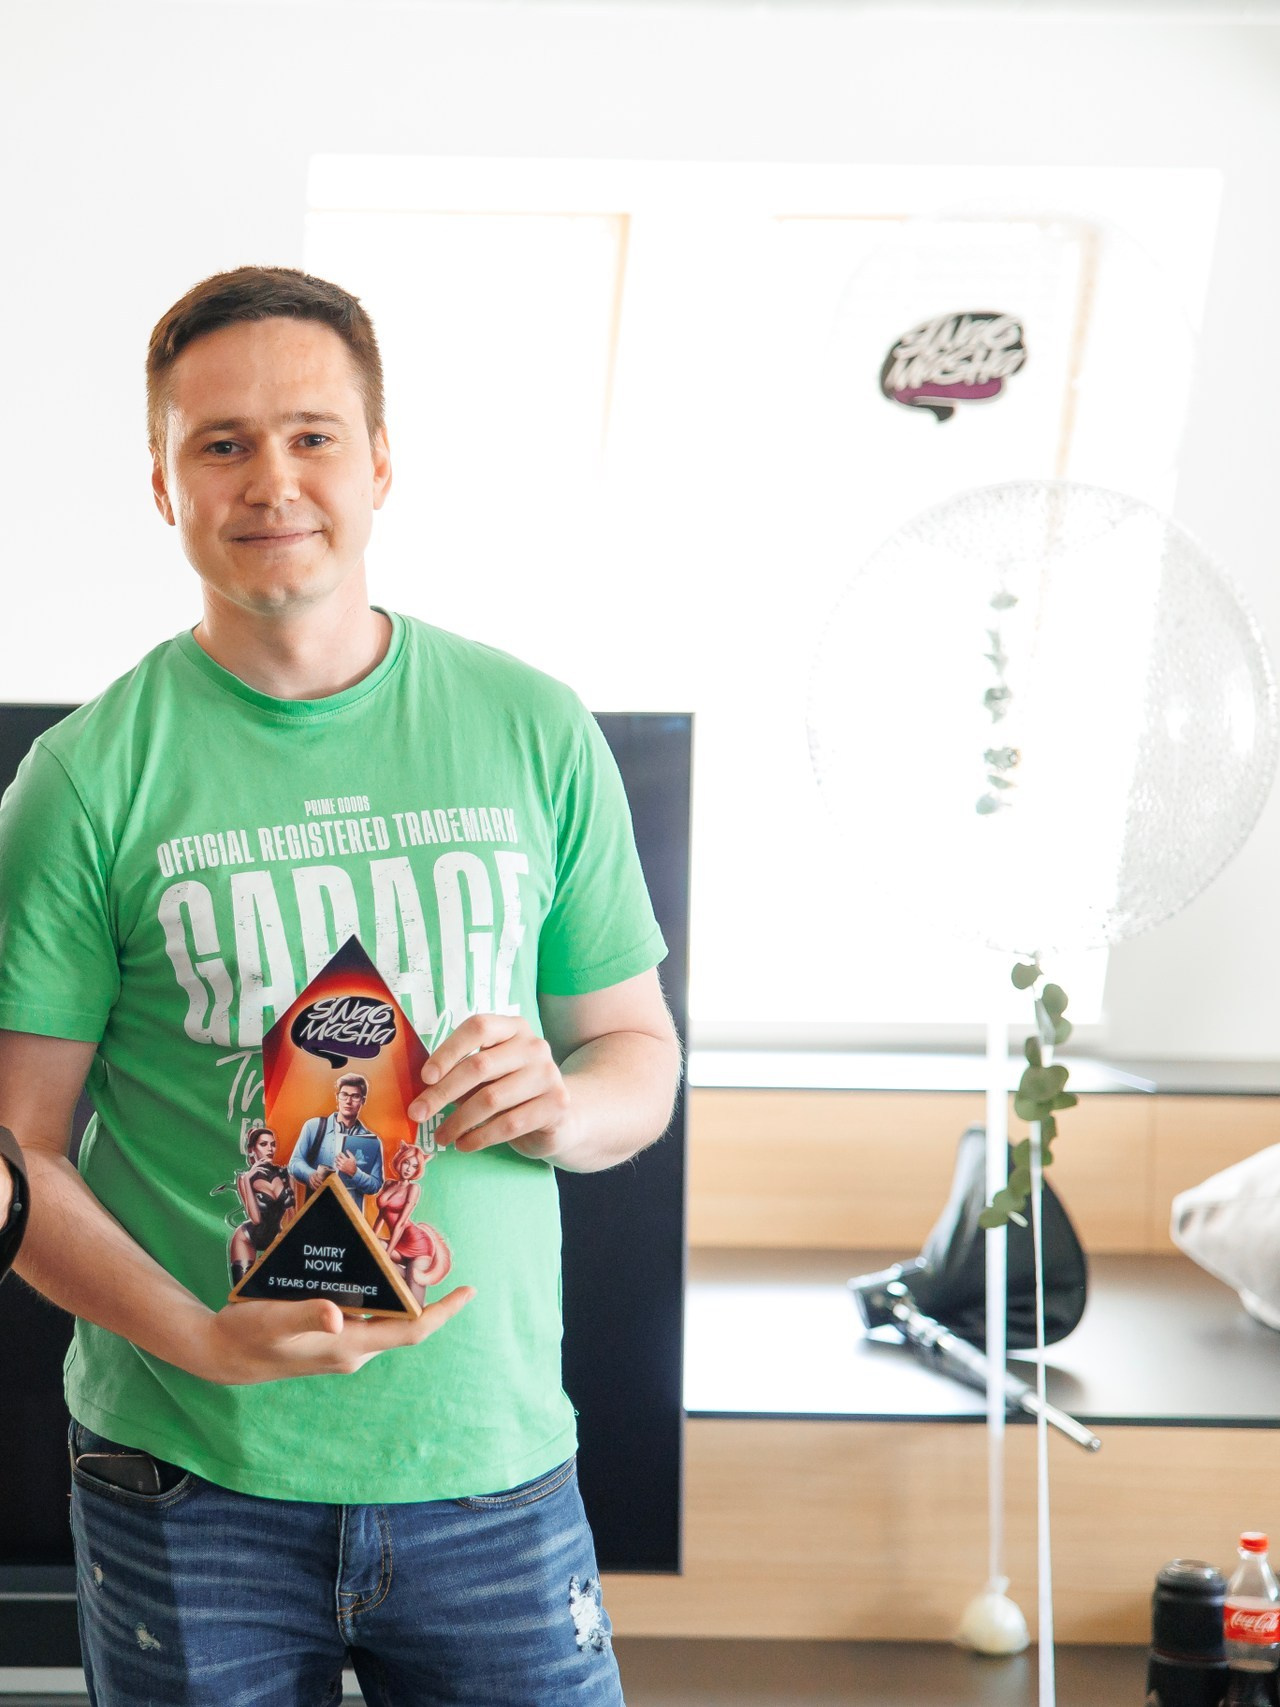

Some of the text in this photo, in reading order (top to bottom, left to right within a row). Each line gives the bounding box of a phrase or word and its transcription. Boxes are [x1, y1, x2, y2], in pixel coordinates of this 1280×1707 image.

[304, 795, 371, 817] PRIME GOODS
[157, 807, 519, 878] OFFICIAL REGISTERED TRADEMARK
[303, 1244, 346, 1259] DMITRY
[304, 1259, 343, 1273] NOVIK
[268, 1276, 378, 1296] 5 YEARS OF EXCELLENCE
